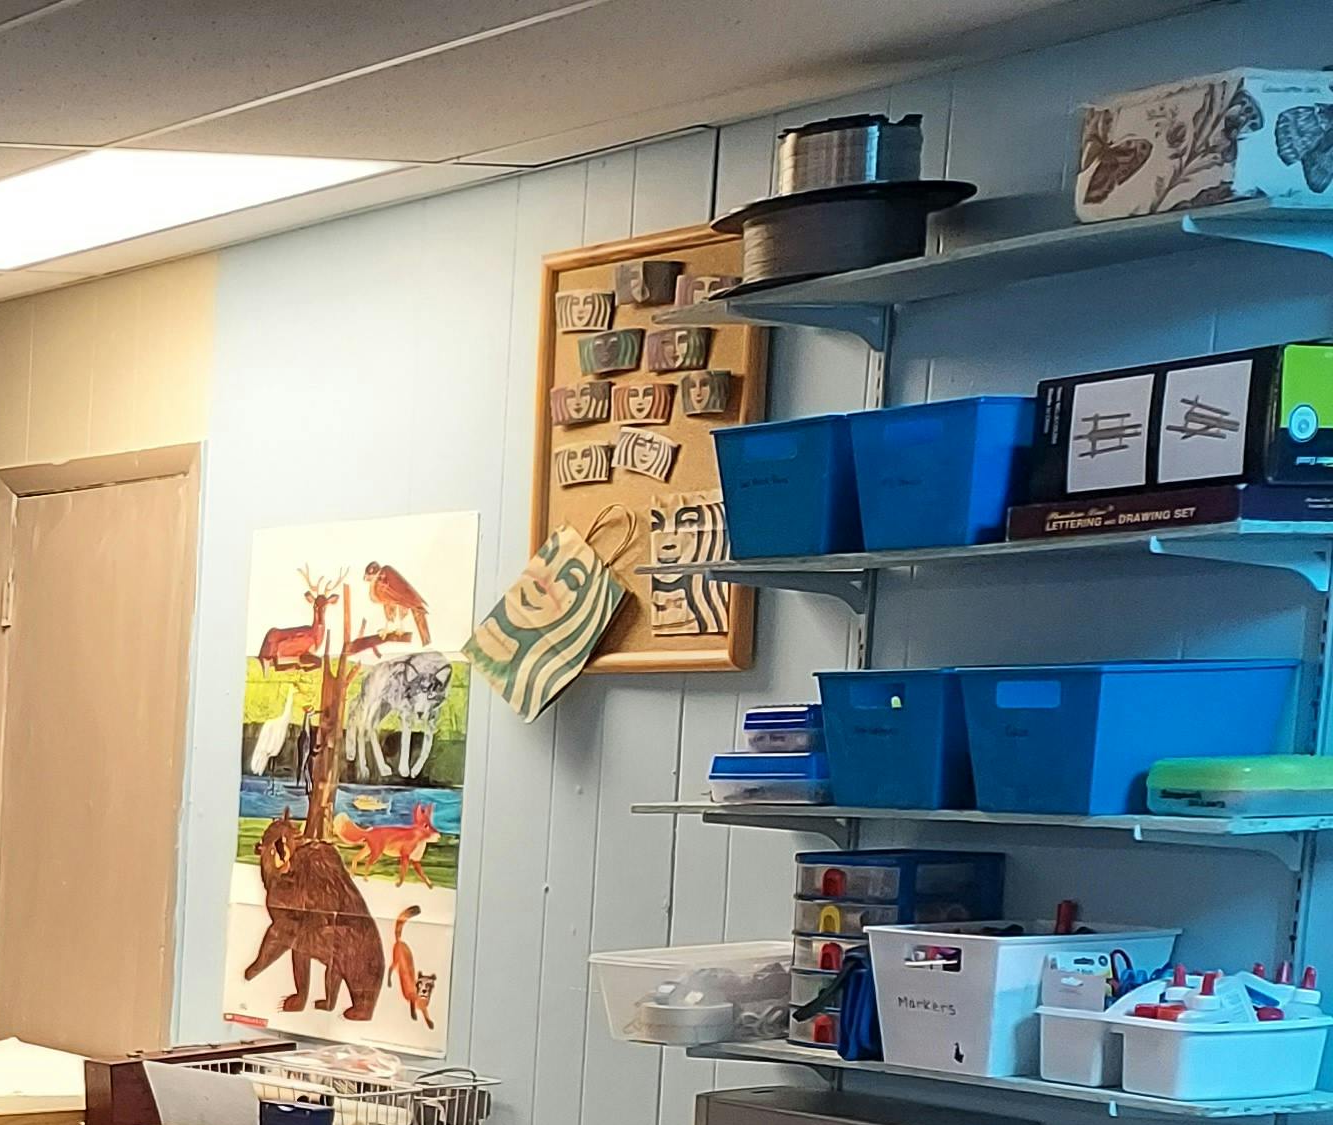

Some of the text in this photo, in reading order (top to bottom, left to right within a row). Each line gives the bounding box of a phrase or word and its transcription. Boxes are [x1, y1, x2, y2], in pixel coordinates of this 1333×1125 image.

[1045, 517, 1102, 532] LETTERING
[1118, 509, 1170, 524] DRAWING
[1173, 507, 1196, 519] SET
[898, 996, 956, 1016] Markers
